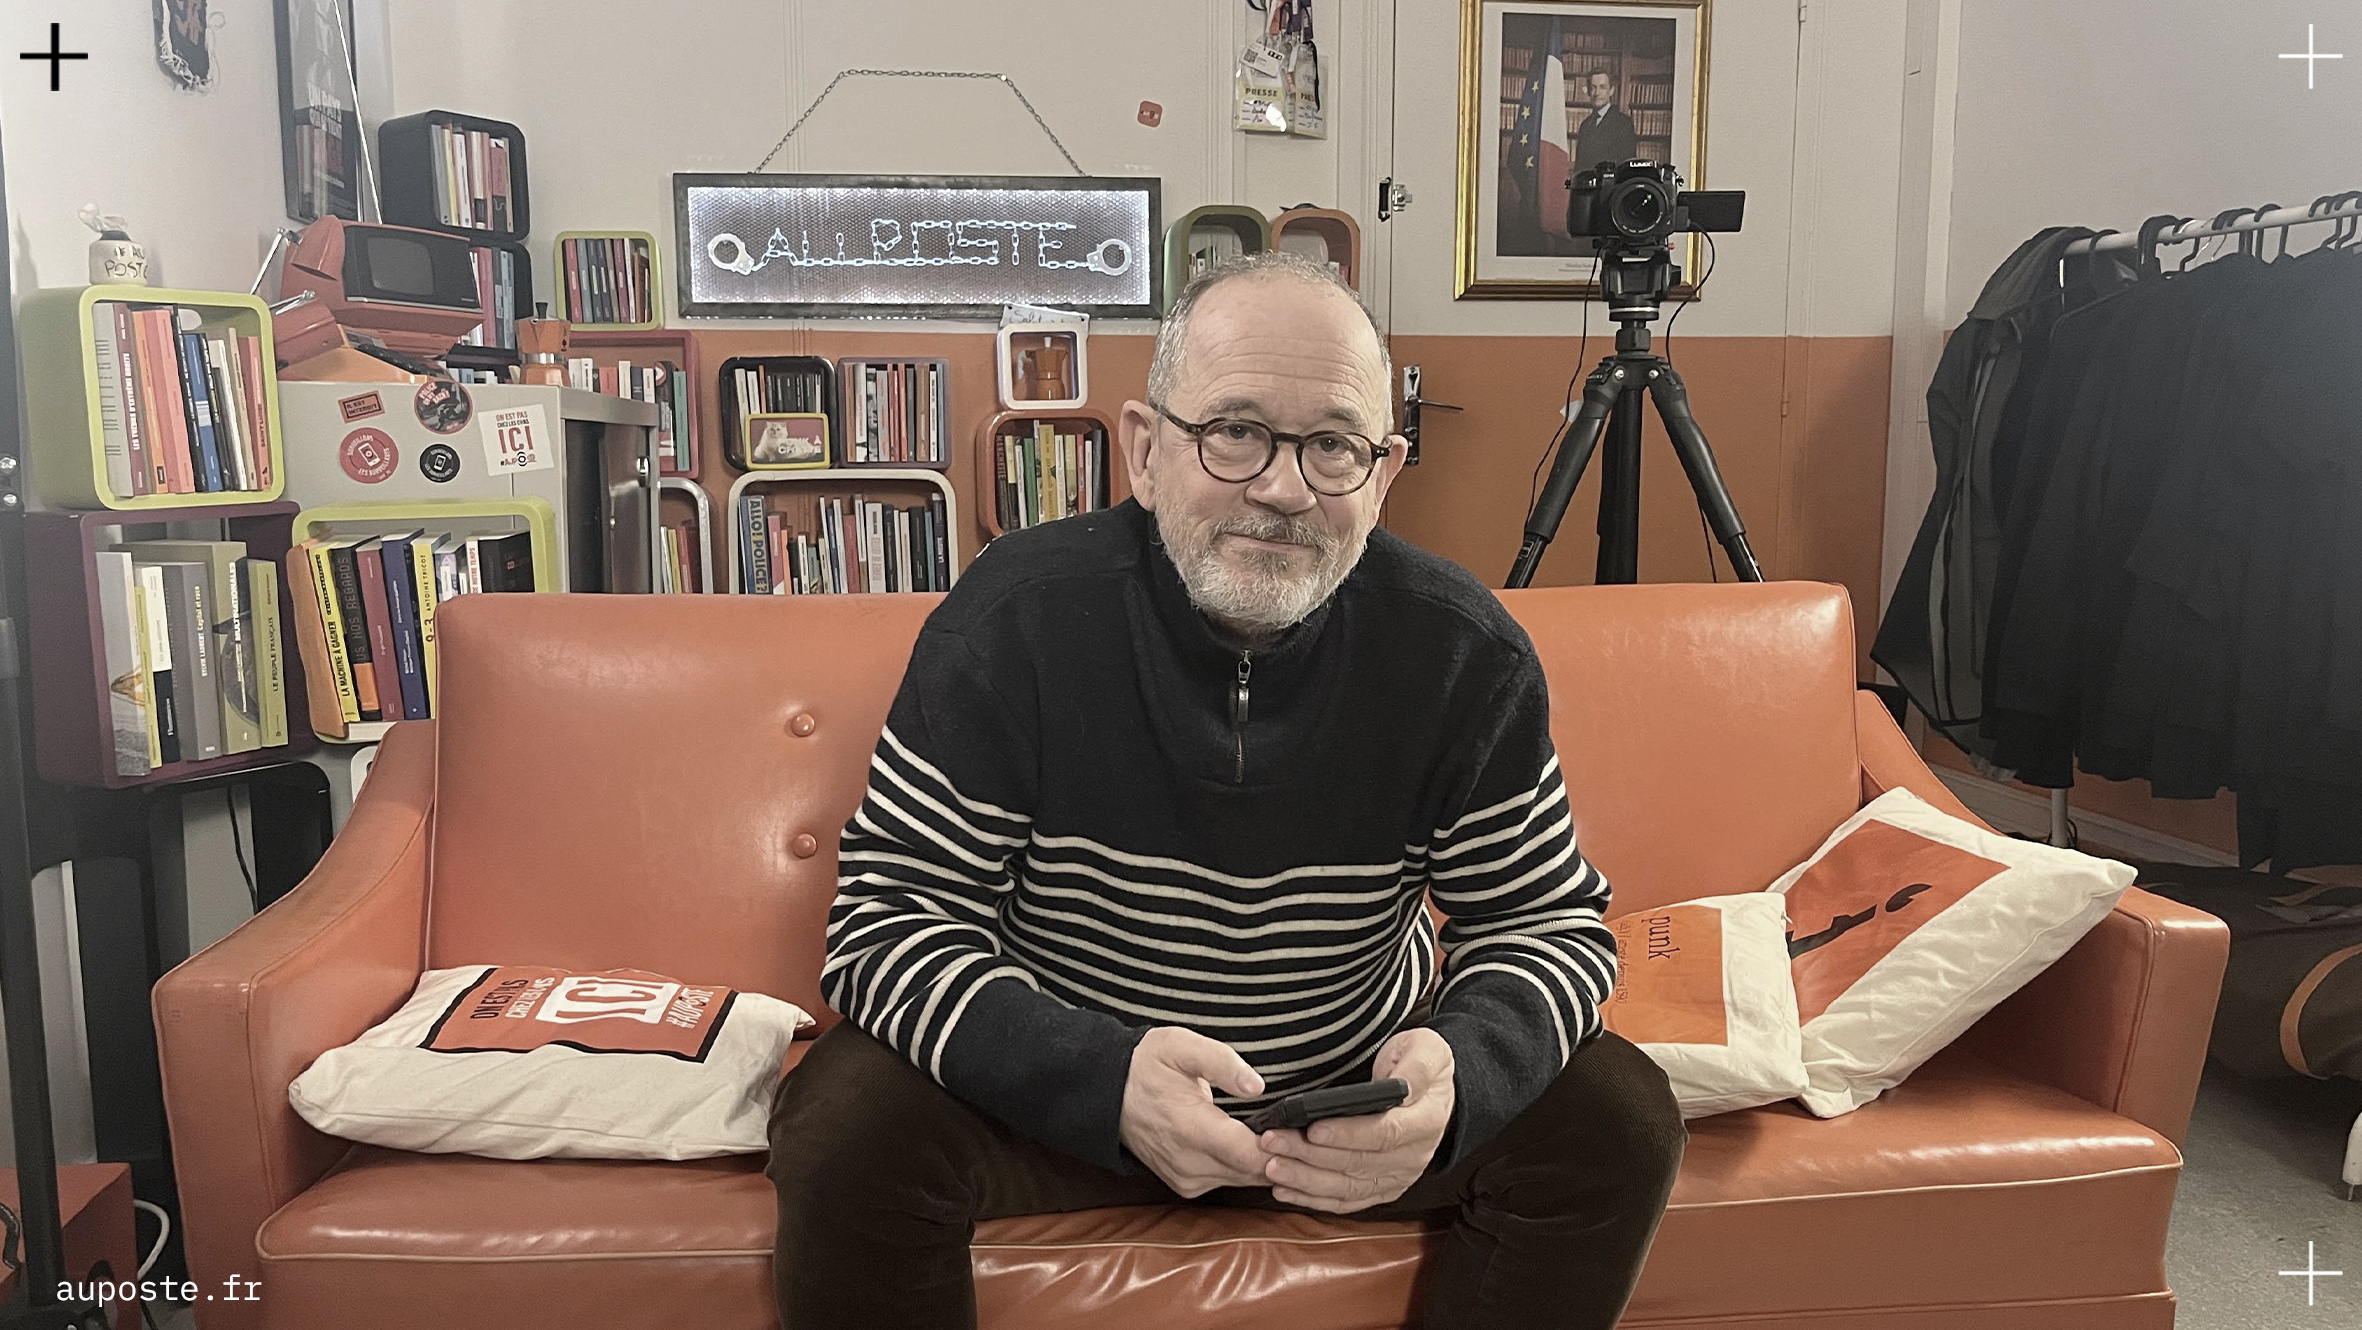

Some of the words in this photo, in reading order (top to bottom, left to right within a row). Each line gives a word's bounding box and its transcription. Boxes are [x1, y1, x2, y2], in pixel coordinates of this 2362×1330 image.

[1245, 87, 1278, 97] PRESSE
[1629, 160, 1652, 168] LUMEX
[496, 414, 505, 422] ON
[505, 412, 516, 420] EST
[516, 410, 528, 419] PAS
[498, 426, 534, 454] ICI
[470, 567, 478, 585] NOTRE
[752, 539, 768, 592] POLICE?
[229, 561, 241, 642] MULTINATIONALES
[423, 581, 431, 611] ANTOINE
[195, 608, 204, 631] Capital
[348, 615, 361, 640] NOS
[267, 616, 276, 651] FRANÇAIS
[328, 621, 340, 648] GAGNER
[270, 653, 278, 680] PEUPLE
[335, 655, 347, 686] MACHINE
[272, 681, 278, 691] LE
[340, 687, 350, 697] LA
[1640, 915, 1681, 961] punk
[1617, 961, 1630, 987] depuis
[554, 979, 664, 1020] ICI
[665, 987, 715, 1029] #AUPOSTE
